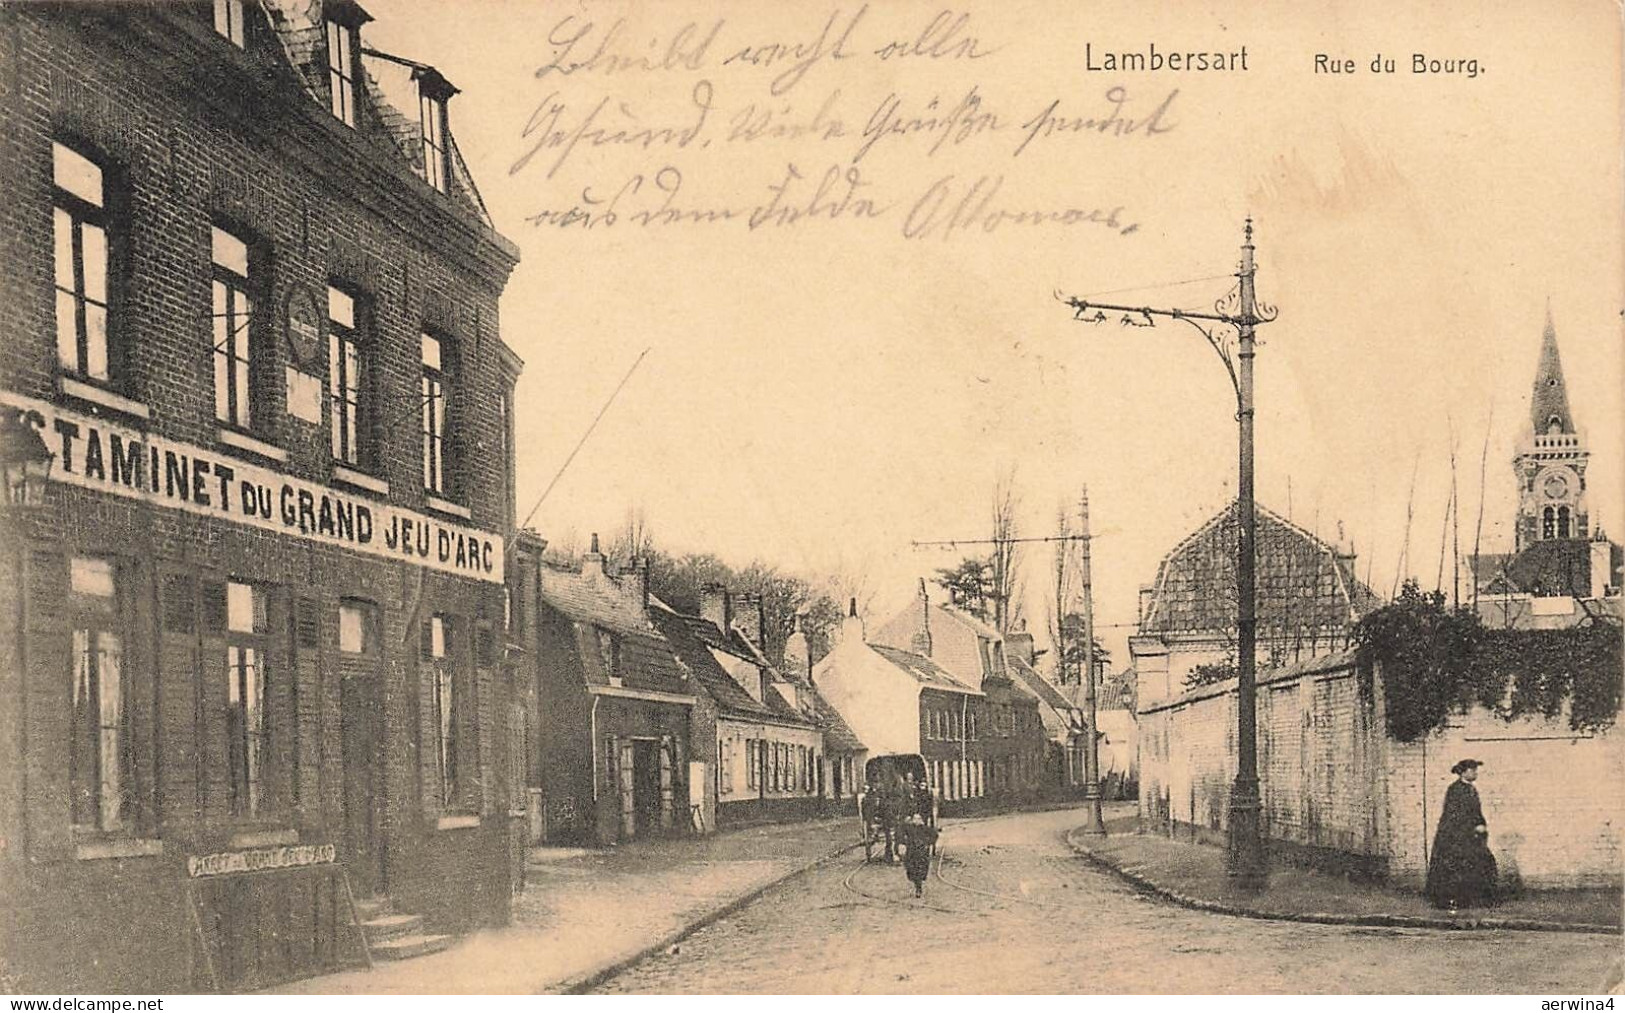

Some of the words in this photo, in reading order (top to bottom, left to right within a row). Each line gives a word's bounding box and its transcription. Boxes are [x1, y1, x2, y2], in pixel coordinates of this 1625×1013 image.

[241, 480, 273, 520] DU
[280, 483, 373, 544] GRAND
[385, 515, 430, 558] JEU
[438, 528, 493, 574] D'ARC
